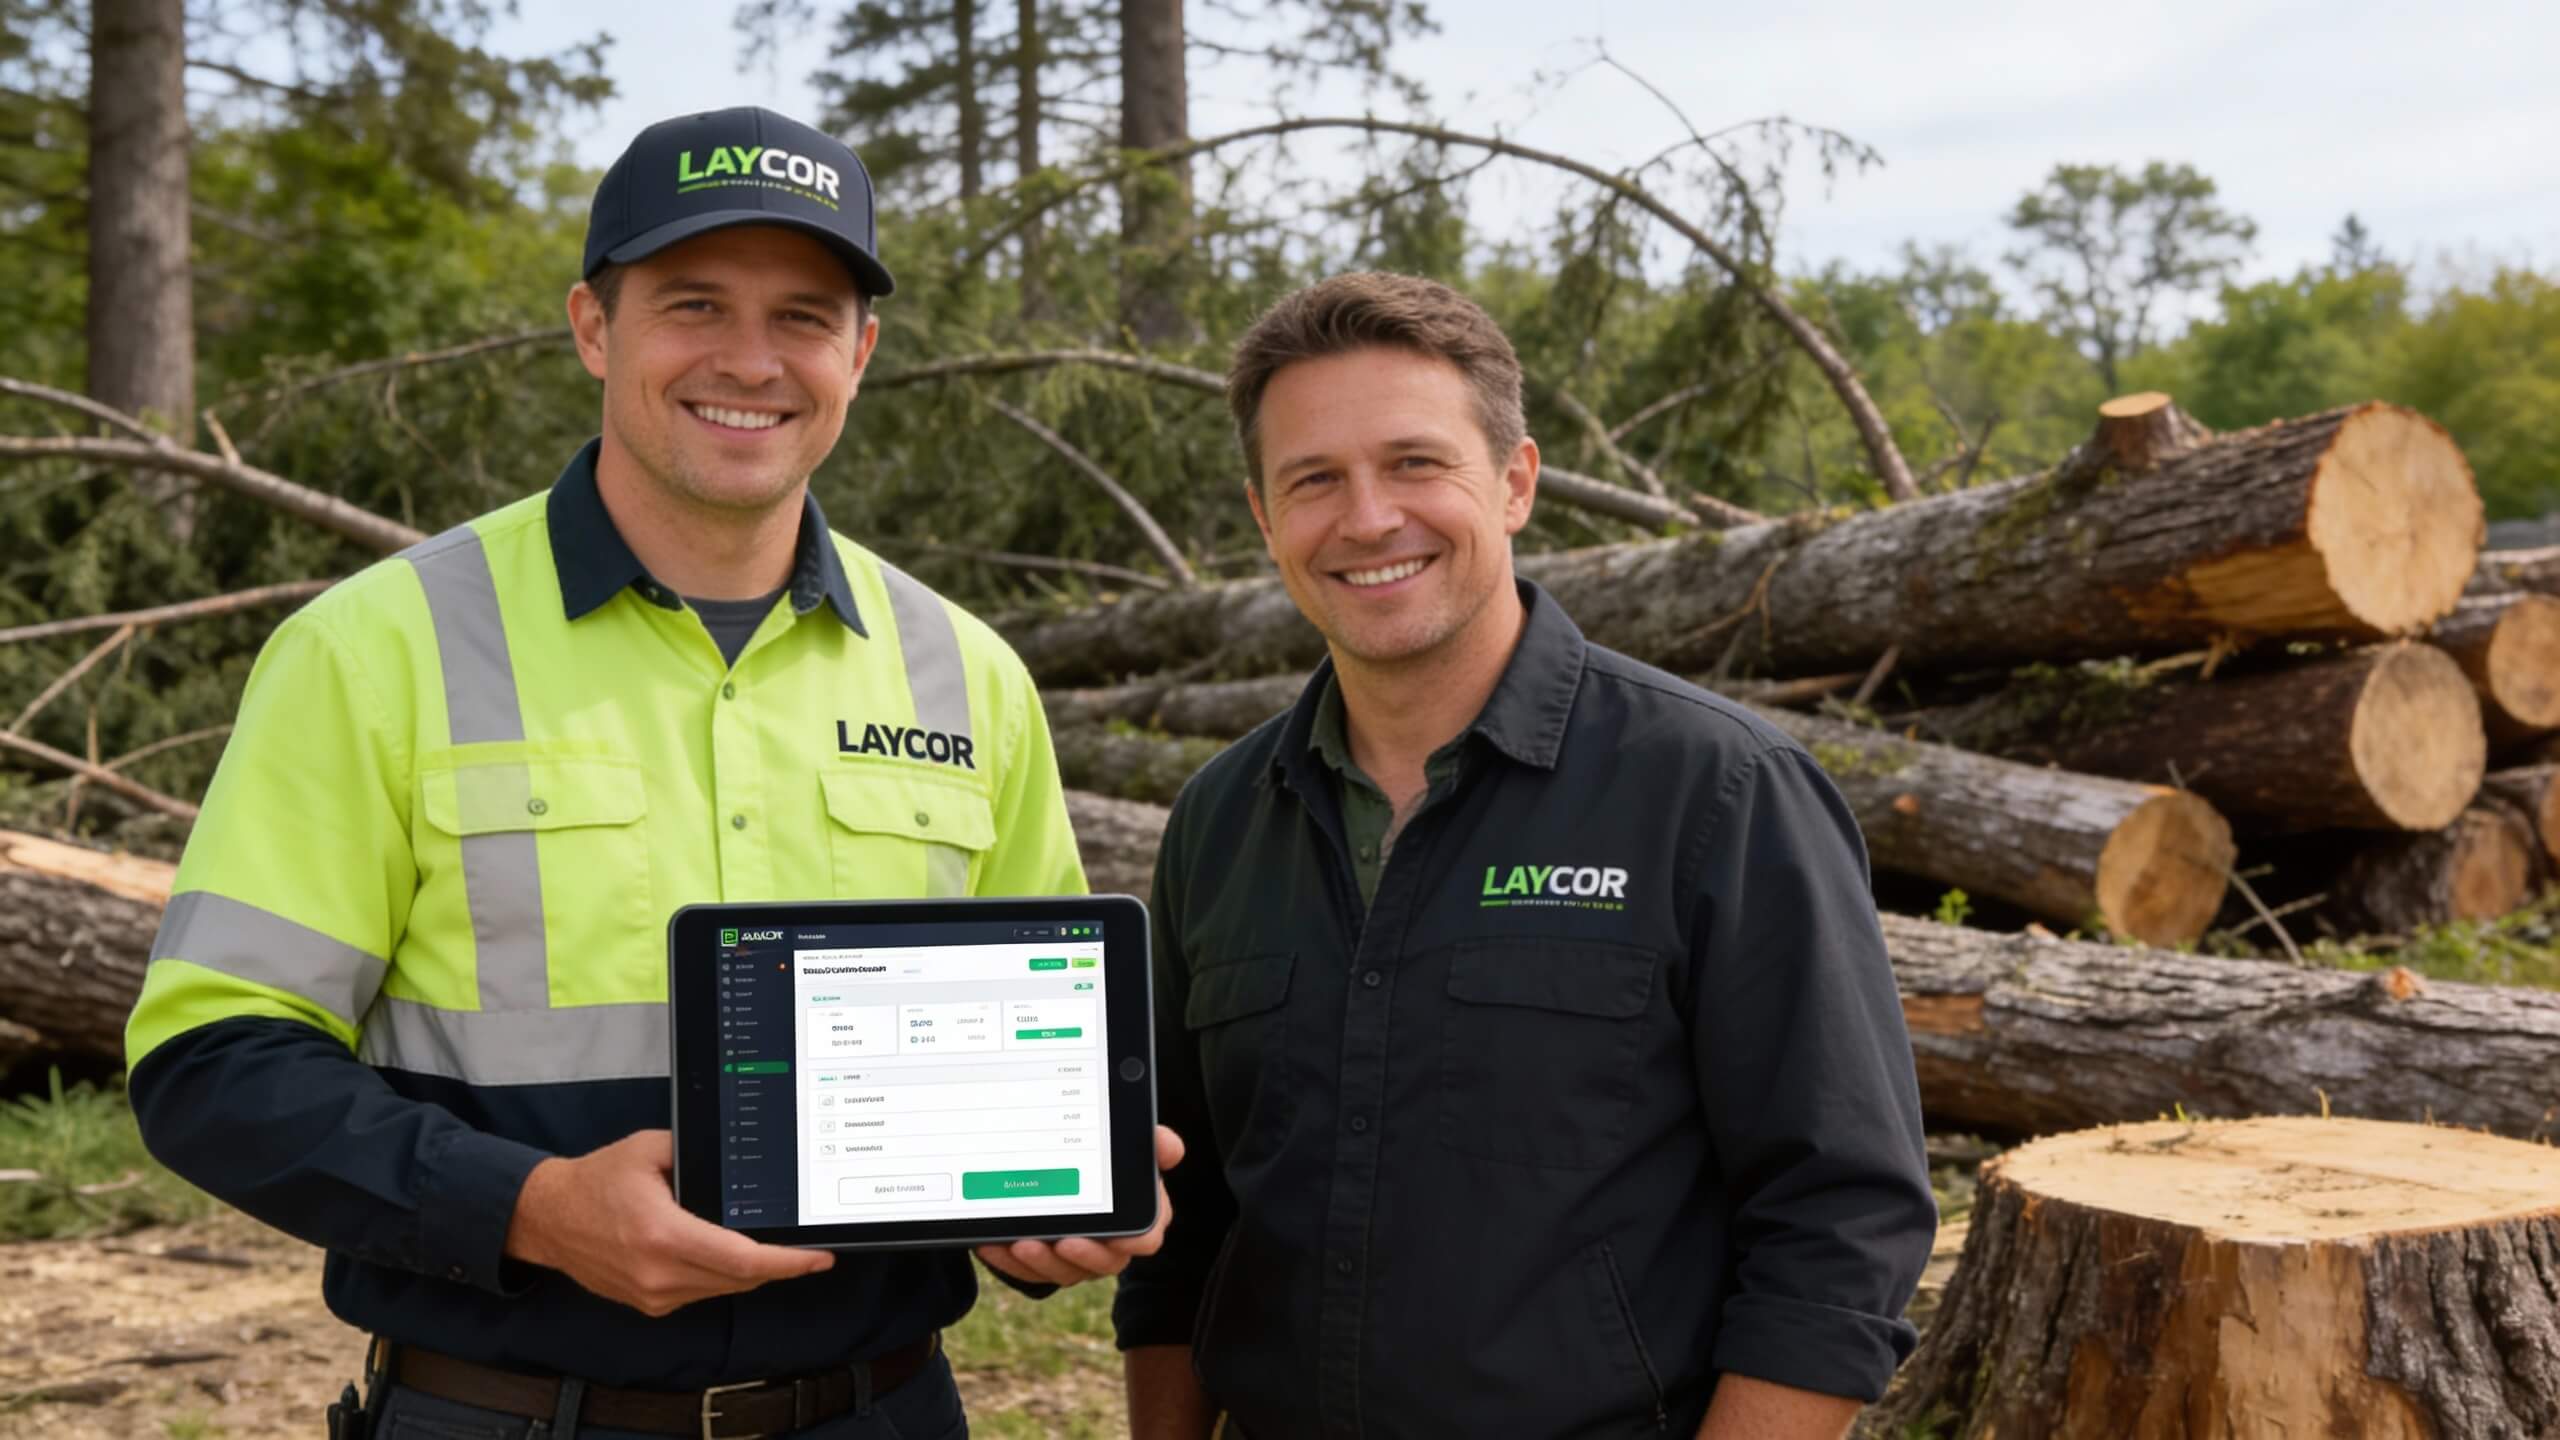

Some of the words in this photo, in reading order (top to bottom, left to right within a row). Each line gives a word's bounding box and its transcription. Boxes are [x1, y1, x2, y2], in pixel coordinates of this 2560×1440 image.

[678, 146, 839, 199] LAYCOR
[836, 720, 976, 769] LAYCOR
[1482, 865, 1629, 898] LAYCOR
